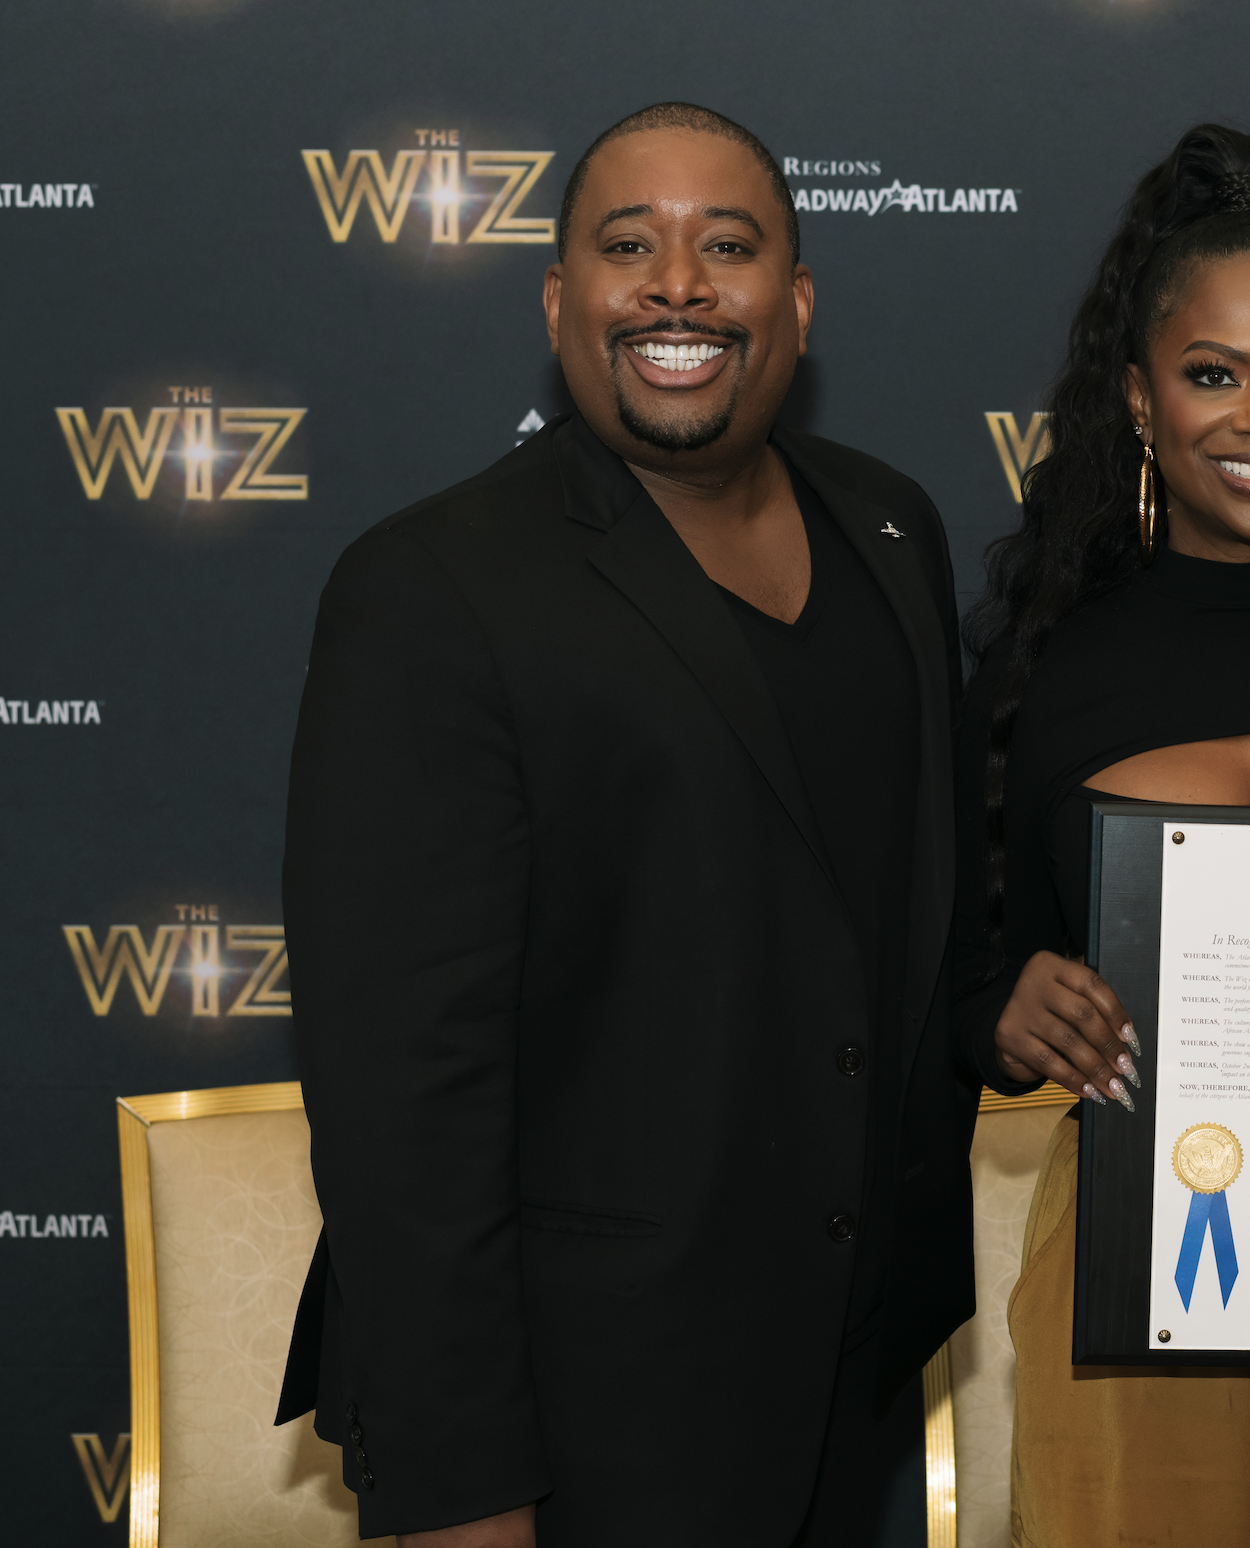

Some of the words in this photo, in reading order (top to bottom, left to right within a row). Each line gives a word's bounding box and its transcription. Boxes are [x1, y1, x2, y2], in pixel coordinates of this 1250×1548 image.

[415, 129, 460, 147] THE
[783, 157, 881, 176] REGIONS
[0, 183, 95, 208] TLANTA
[301, 149, 556, 245] WIZ
[793, 189, 885, 216] ADWAY
[903, 184, 1018, 213] ATLANTA
[169, 387, 213, 404] THE
[55, 407, 309, 501] WIZ
[175, 904, 220, 921] THE
[1212, 934, 1224, 945] In
[1183, 952, 1222, 960] WHEREAS,
[62, 924, 293, 1017] WIZ
[1181, 1017, 1220, 1025] WHEREAS,
